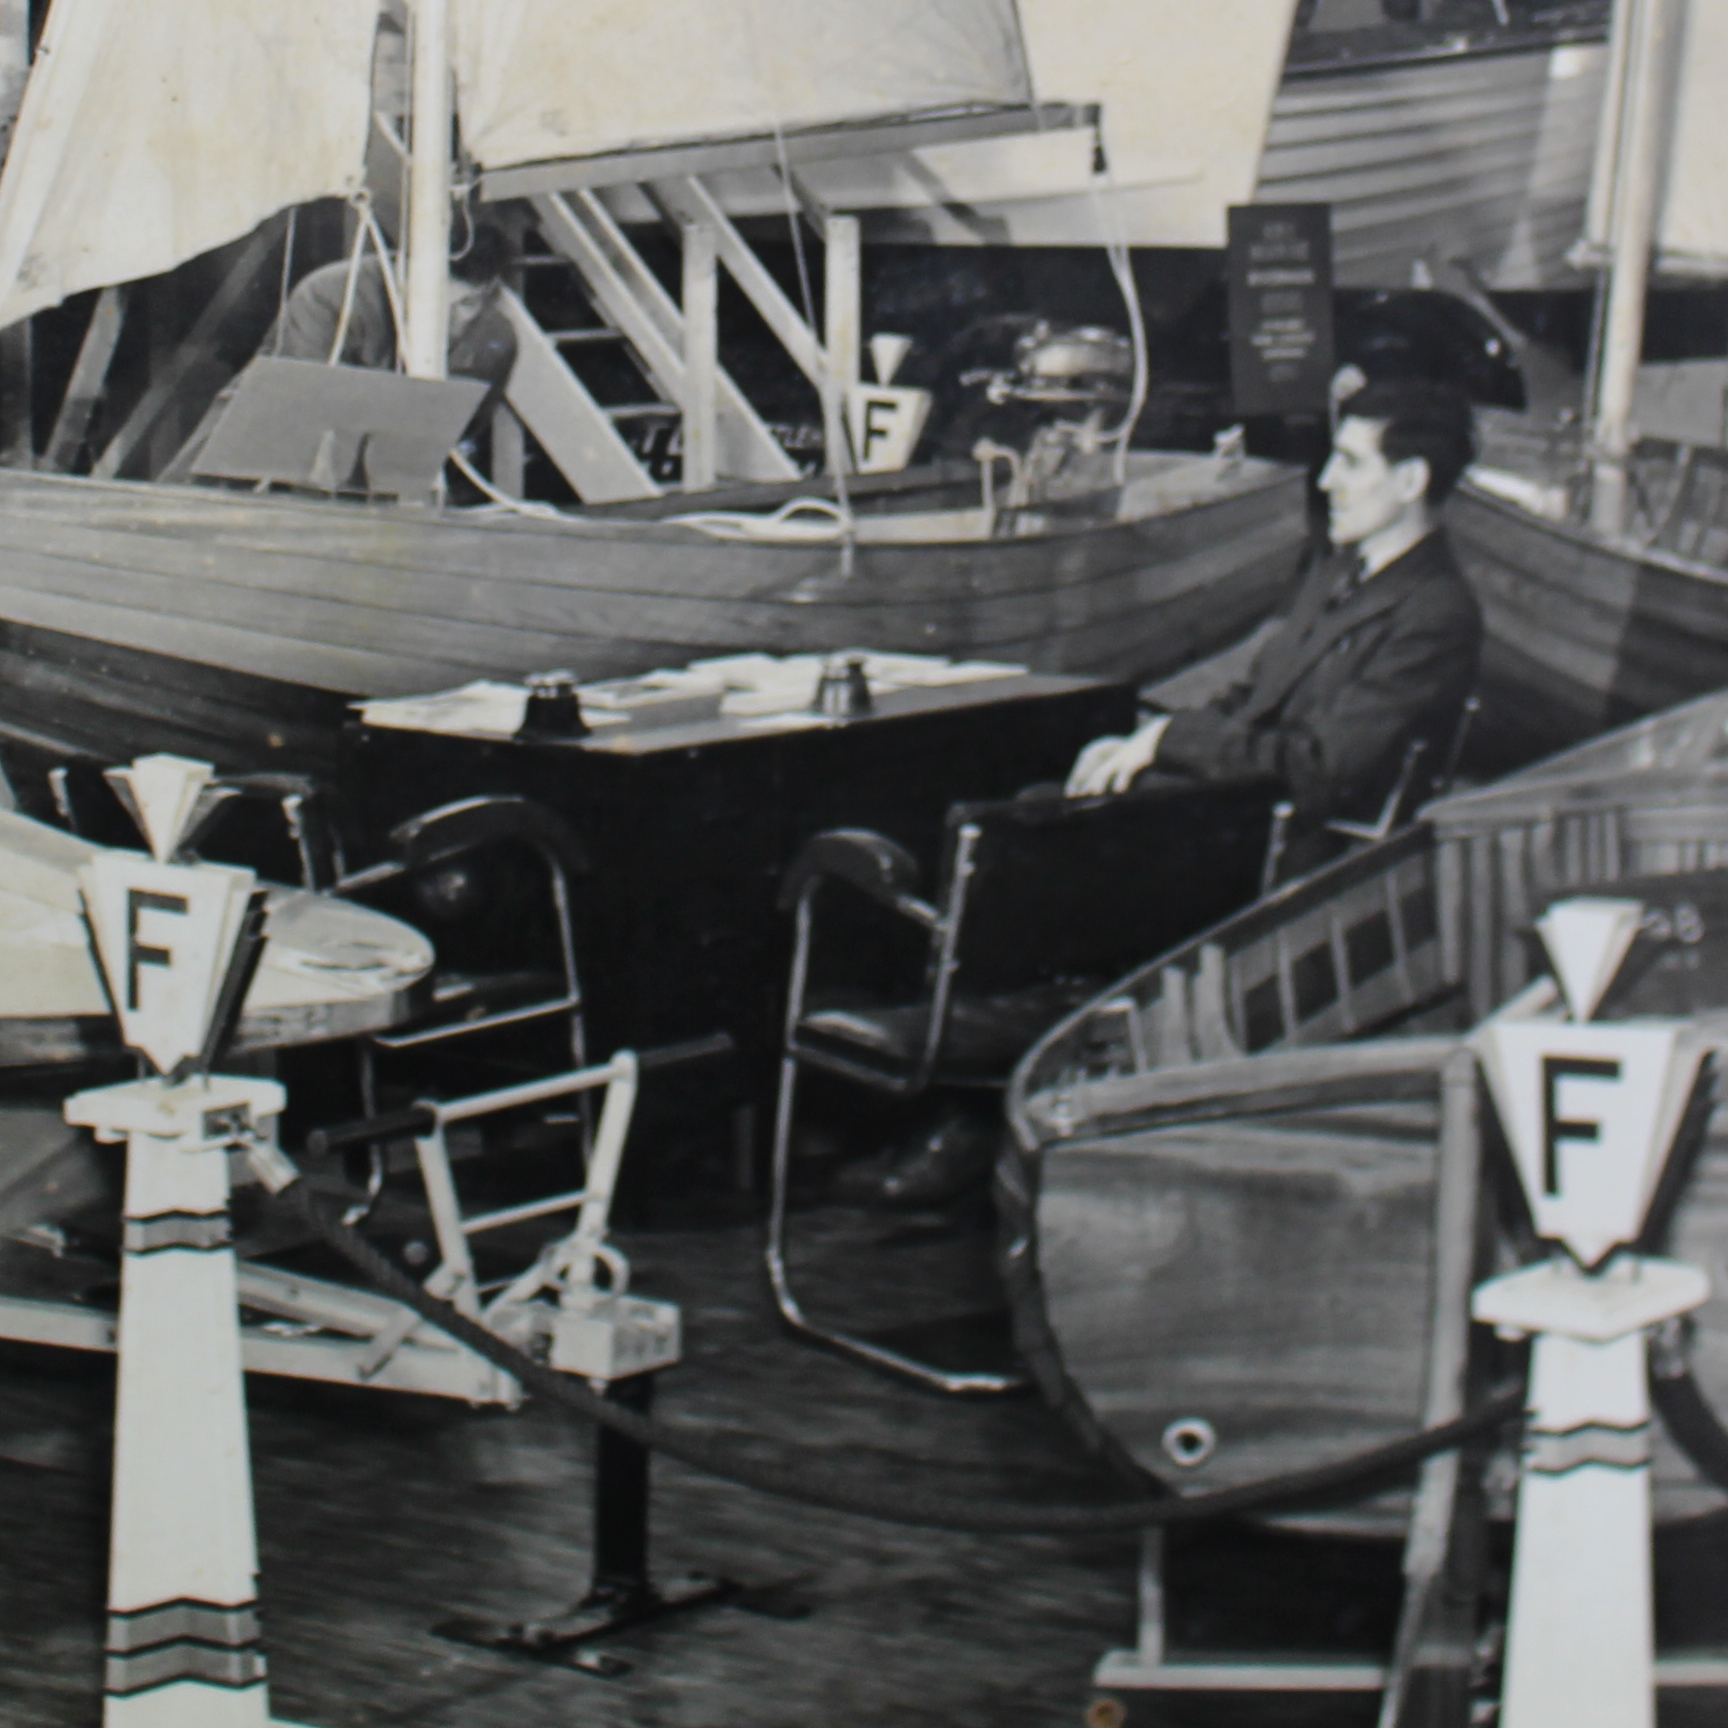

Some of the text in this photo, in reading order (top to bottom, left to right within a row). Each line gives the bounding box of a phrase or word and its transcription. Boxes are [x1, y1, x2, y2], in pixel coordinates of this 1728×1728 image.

[858, 401, 900, 460] F
[126, 888, 190, 1014] F
[1539, 1055, 1622, 1199] F
